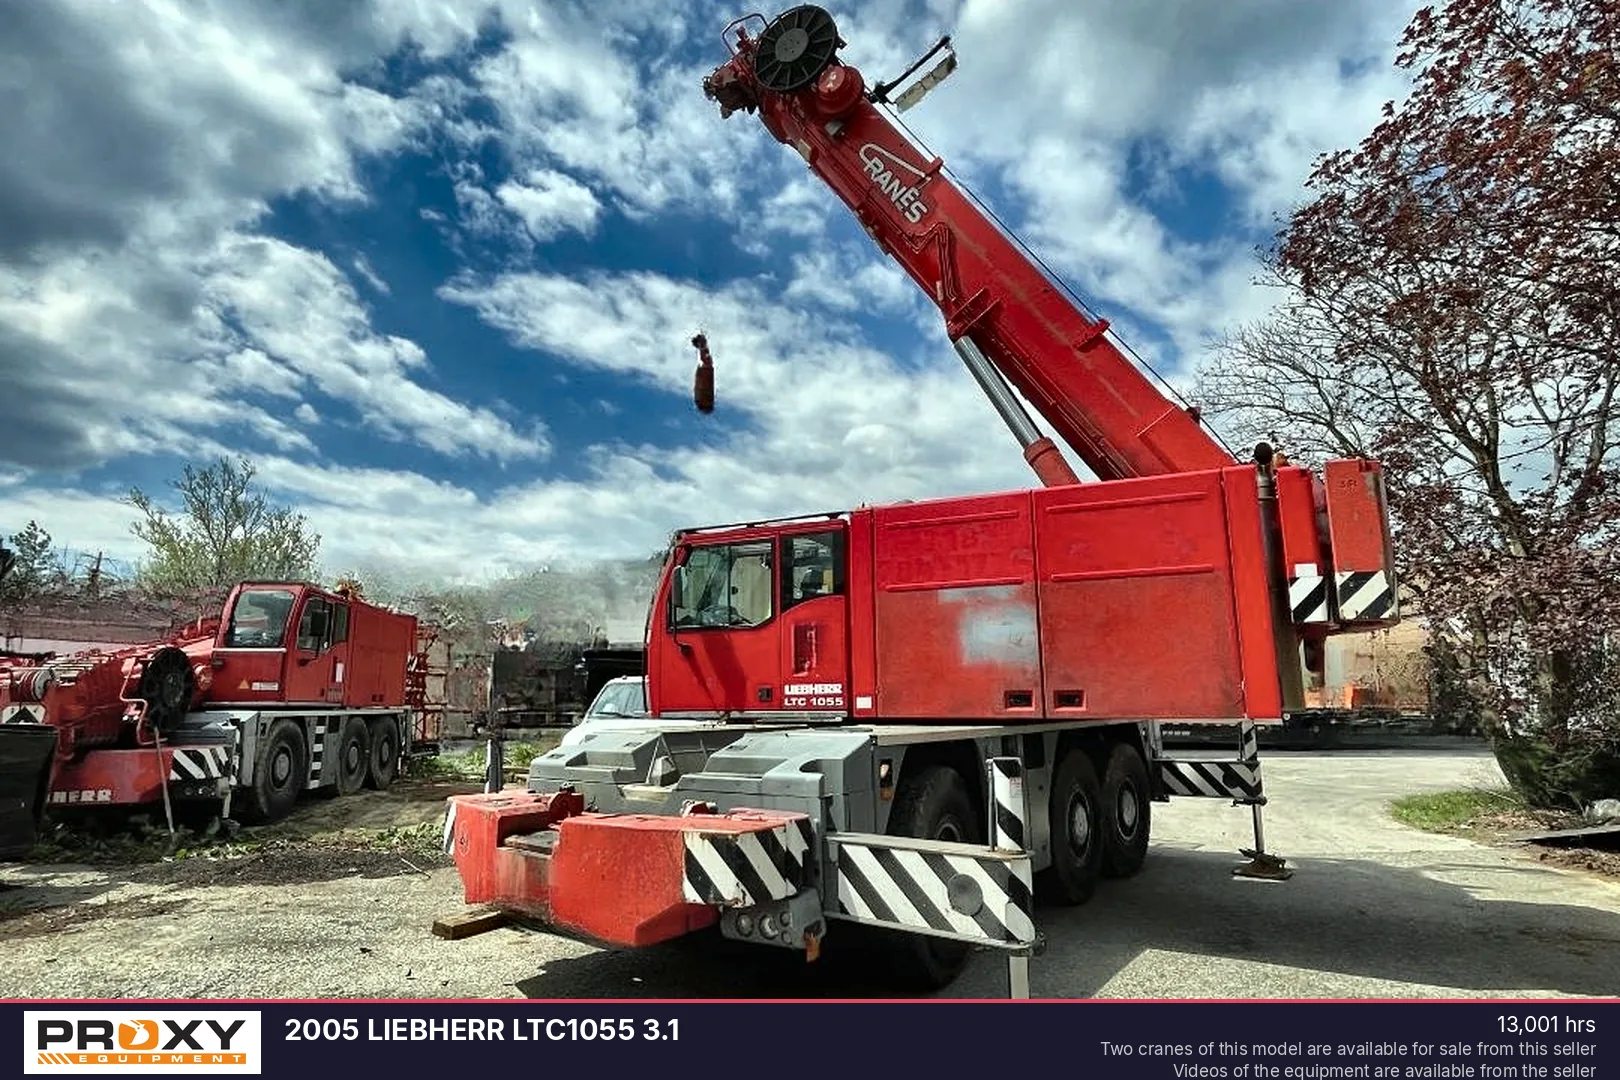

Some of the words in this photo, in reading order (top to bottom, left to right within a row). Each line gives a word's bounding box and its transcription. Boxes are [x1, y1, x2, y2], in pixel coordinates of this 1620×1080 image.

[784, 683, 843, 695] LIEBHERR
[784, 697, 806, 706] LTC
[810, 697, 844, 706] 1055
